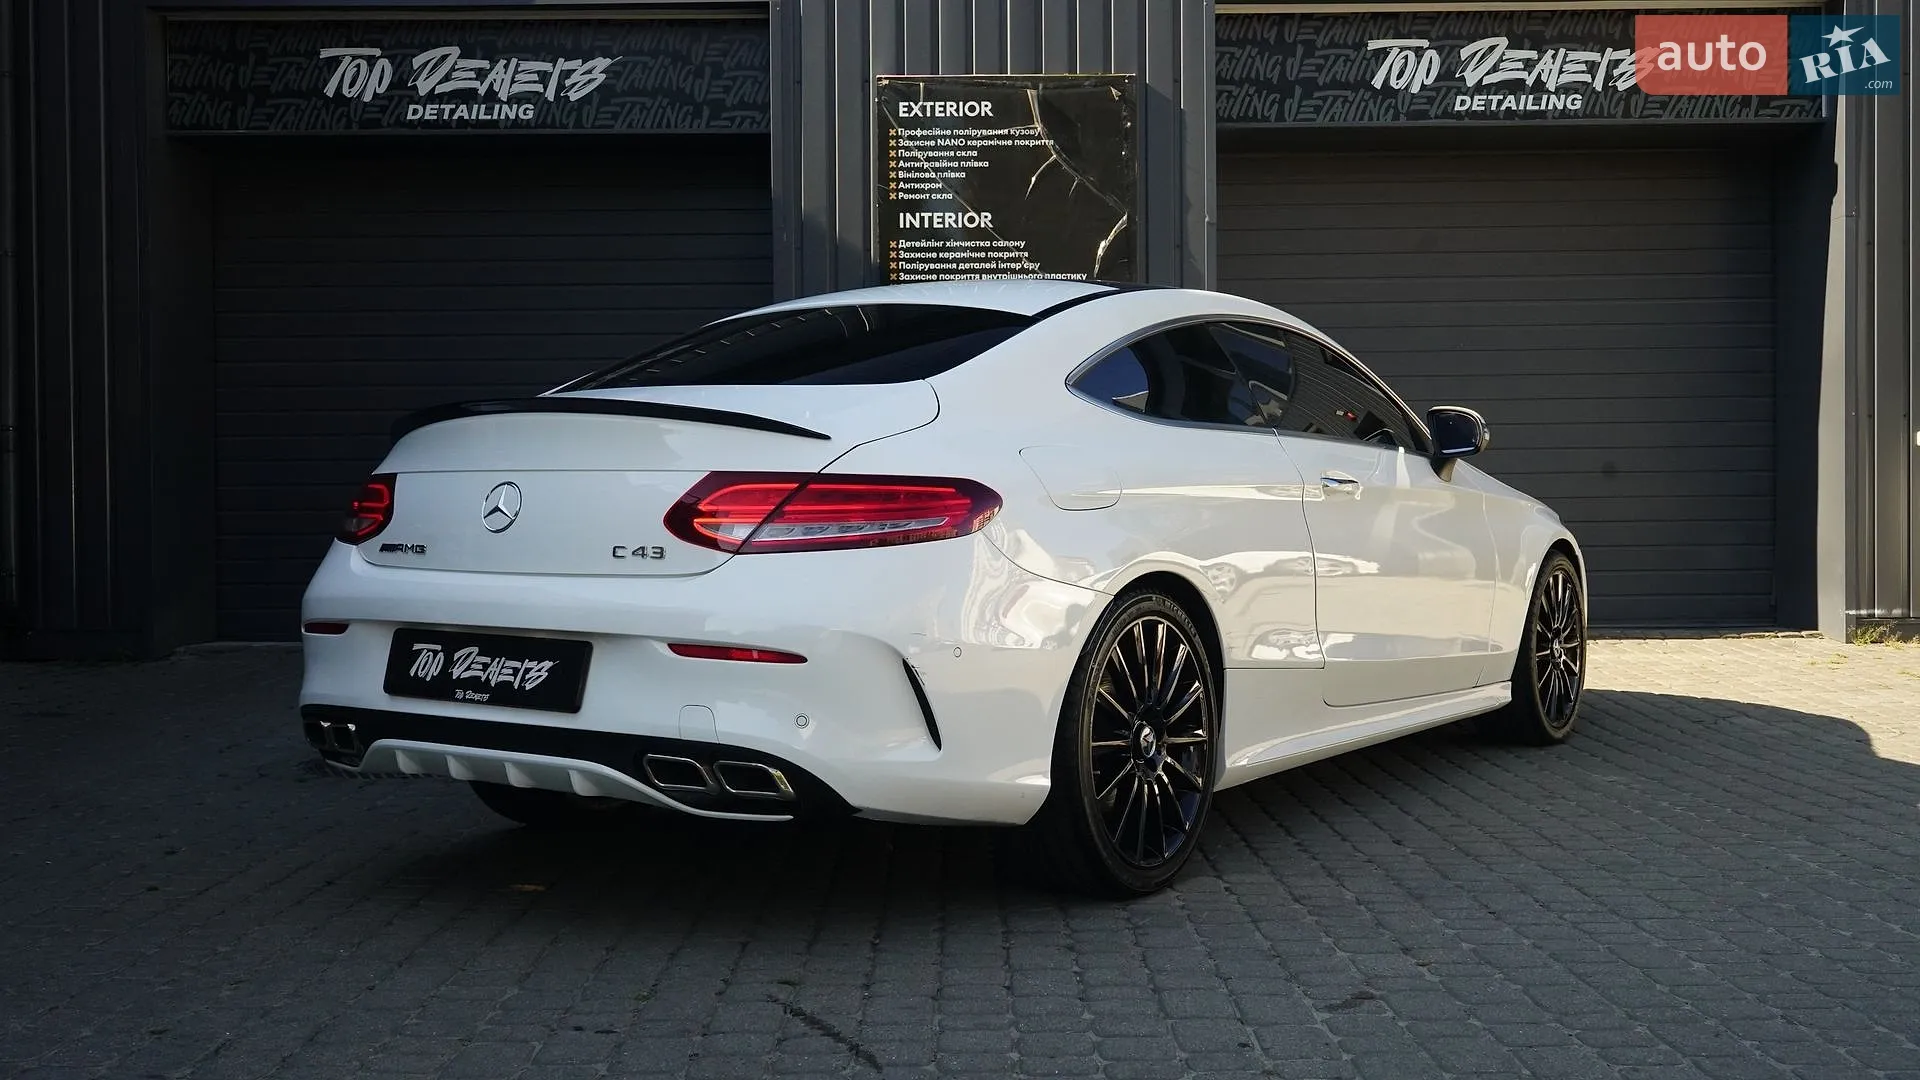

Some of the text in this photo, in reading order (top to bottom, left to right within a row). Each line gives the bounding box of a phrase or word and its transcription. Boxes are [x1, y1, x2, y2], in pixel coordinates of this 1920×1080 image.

[1367, 39, 1440, 94] TOP
[319, 47, 393, 102] TOP
[1453, 94, 1583, 112] DETAILING
[407, 103, 535, 121] DETAILING
[898, 101, 994, 117] EXTERIOR
[898, 128, 1040, 138] Професійне полірування кузову
[937, 138, 966, 146] NANO
[967, 138, 1013, 148] керамічне
[1014, 138, 1054, 147] покриття
[898, 149, 978, 160] Полірування скла
[898, 160, 989, 170] Антигравійна плівка
[898, 171, 966, 179] Вінілова плівка
[898, 181, 942, 190] Антихром
[898, 192, 953, 200] Ремонт скла
[898, 212, 994, 229] INTERIOR
[898, 239, 1026, 249] Детейлінг хімчистка салону
[898, 250, 1029, 260] Захисне керамічне покриття
[898, 262, 956, 271] Полірування
[958, 261, 997, 270] деталей
[898, 272, 937, 281] Захисне
[390, 543, 427, 554] AMG
[612, 545, 666, 560] C 43
[408, 643, 445, 682] TOP
